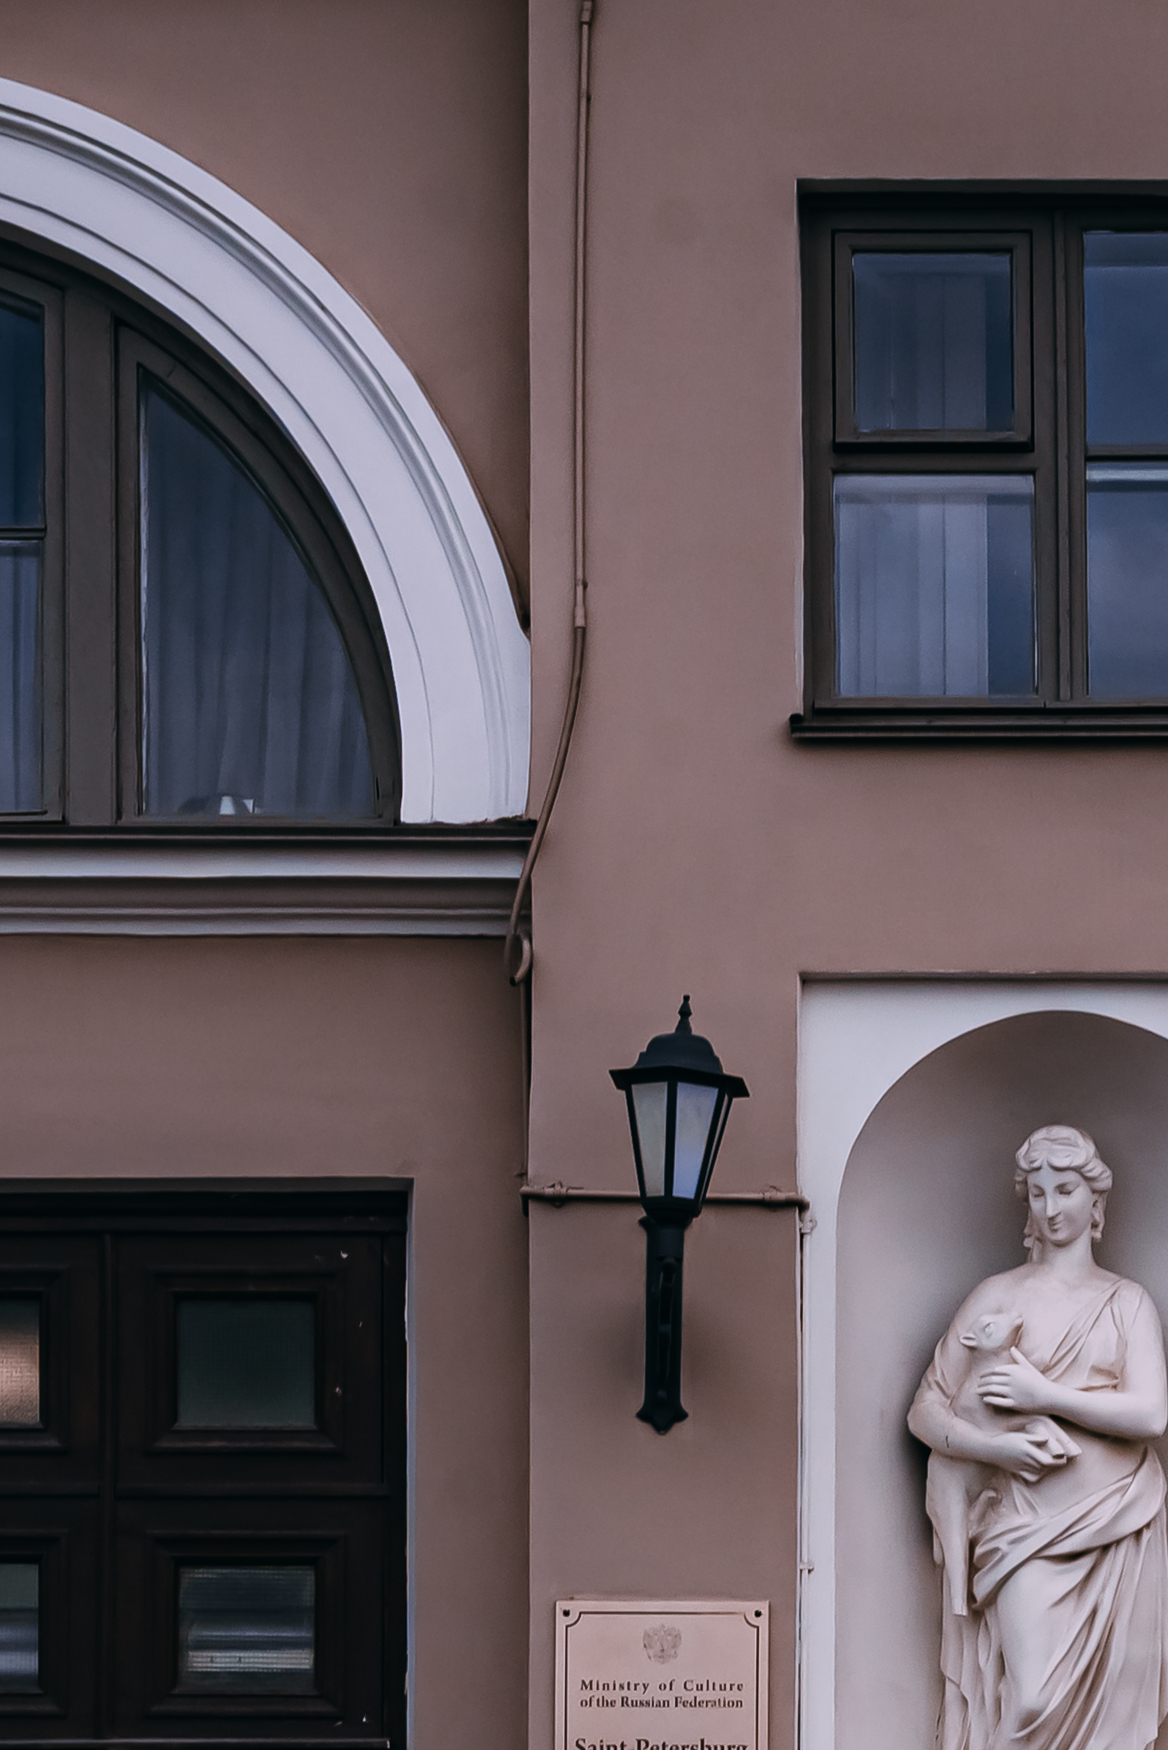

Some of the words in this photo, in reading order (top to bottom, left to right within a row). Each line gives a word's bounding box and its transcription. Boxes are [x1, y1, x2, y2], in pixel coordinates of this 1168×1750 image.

[580, 1679, 650, 1694] Ministry
[658, 1679, 675, 1692] of
[683, 1679, 744, 1692] Culture
[580, 1696, 595, 1708] of
[595, 1696, 616, 1708] the
[620, 1696, 670, 1708] Russian
[674, 1696, 743, 1708] Federation
